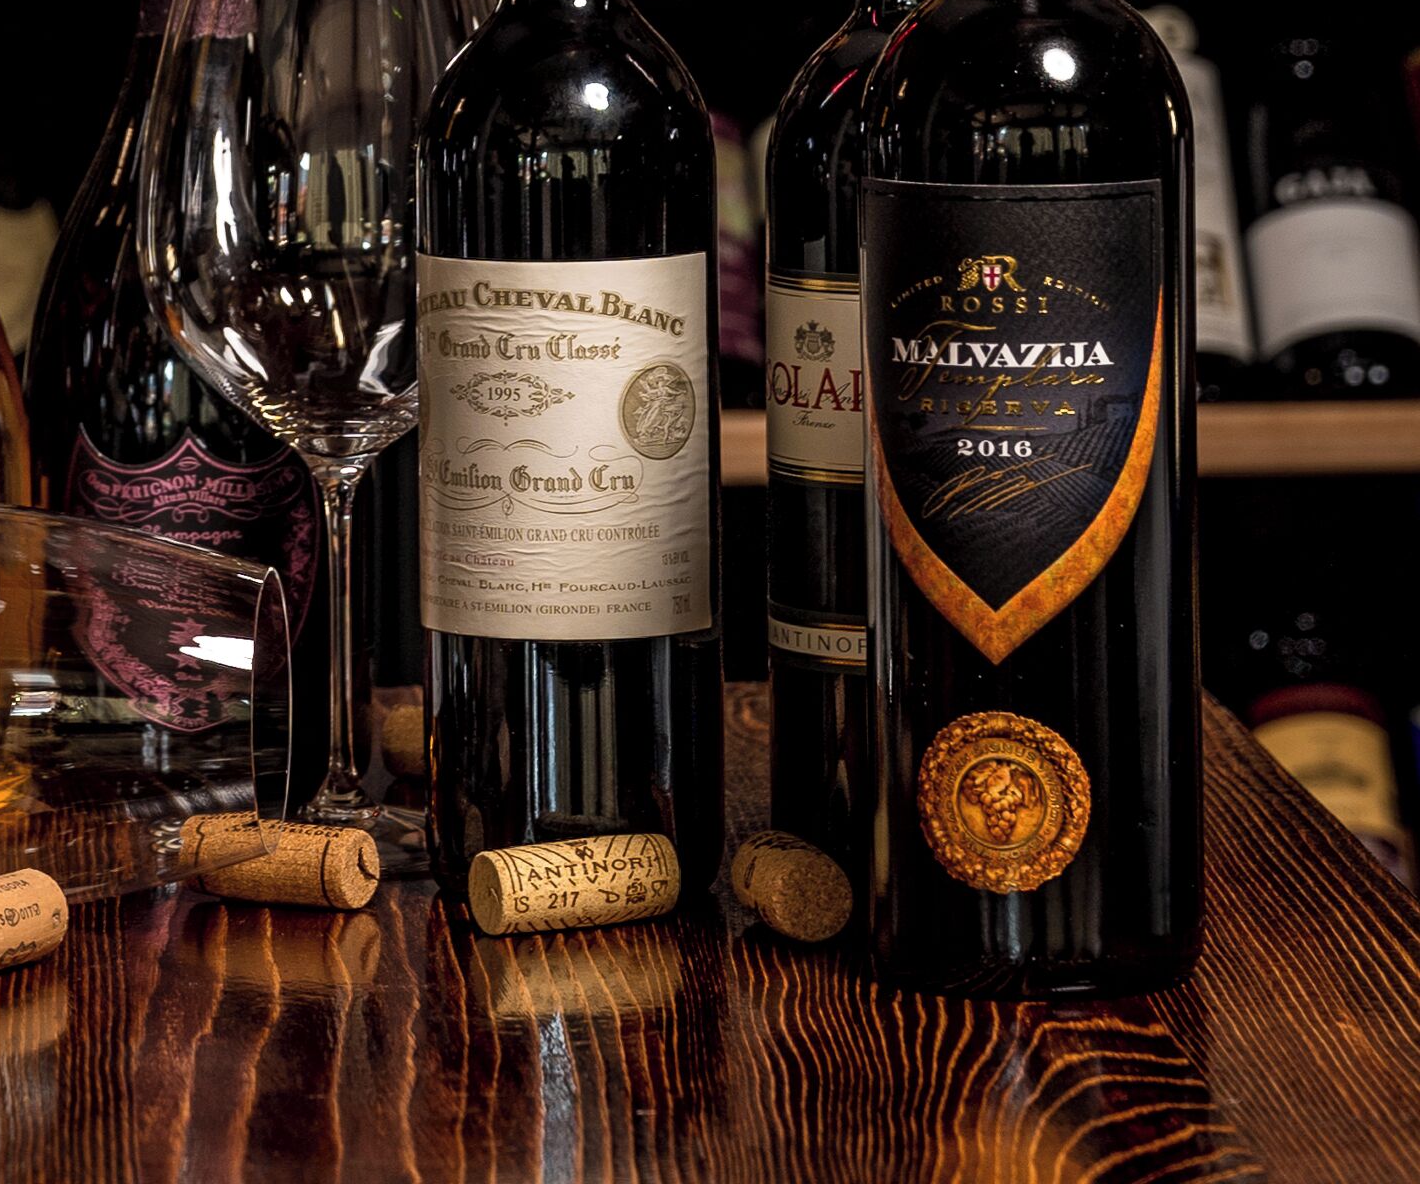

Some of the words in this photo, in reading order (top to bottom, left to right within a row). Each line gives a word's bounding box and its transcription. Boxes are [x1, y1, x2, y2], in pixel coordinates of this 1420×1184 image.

[891, 275, 943, 309] LIMITED
[473, 281, 594, 314] CHEVAL
[598, 290, 685, 337] BLANC
[940, 295, 1048, 314] ROSSI
[439, 329, 491, 359] Grand
[495, 333, 541, 361] Cru
[546, 332, 622, 361] Classé
[891, 336, 1115, 368] MALVAZIJA
[487, 385, 521, 402] 1995
[920, 398, 1076, 415] RISERVA
[957, 439, 1033, 458] 2016
[509, 464, 583, 493] Grand
[588, 464, 635, 492] Cru
[527, 526, 567, 542] GRAND
[571, 526, 595, 542] CRU
[597, 523, 660, 542] CONTRÔLÉE
[465, 553, 516, 567] Château
[536, 602, 600, 615] (GIRONDE)
[606, 600, 653, 614] FRANCE
[528, 856, 653, 882] ANTINORI
[548, 891, 579, 909] 217
